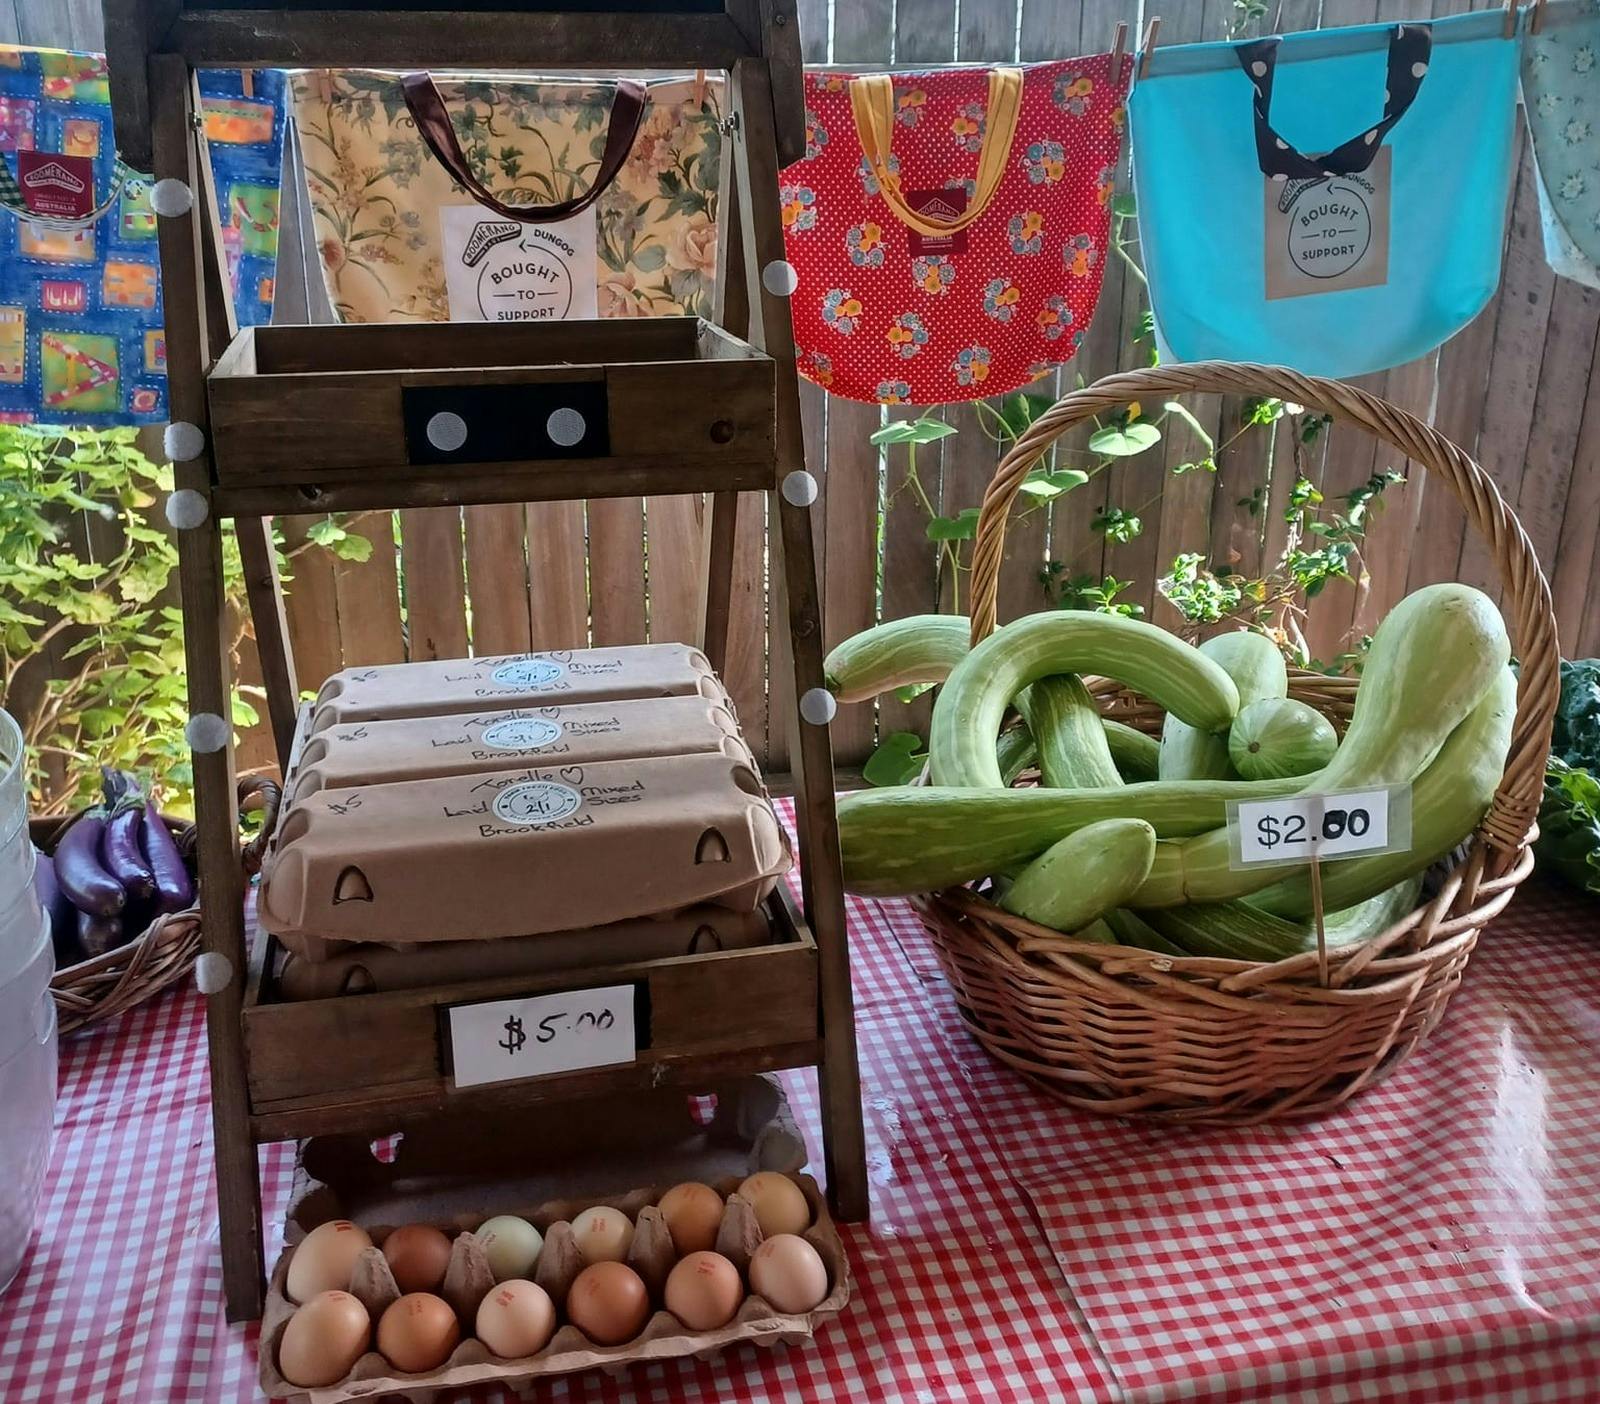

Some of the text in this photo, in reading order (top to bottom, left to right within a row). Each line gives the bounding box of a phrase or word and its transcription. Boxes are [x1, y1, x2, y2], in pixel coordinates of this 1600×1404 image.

[35, 201, 76, 212] AUSTRALIA
[1300, 203, 1359, 227] BOUGHT
[1322, 228, 1337, 238] TO
[466, 224, 516, 260] BOOMERANG
[534, 228, 575, 257] DUNGOG
[1302, 244, 1356, 260] SUPPORT
[490, 262, 560, 285] BOUGHT
[517, 290, 536, 300] TO
[497, 307, 555, 321] SUPPORT
[431, 734, 473, 748] Laid
[471, 744, 571, 760] Brookfield
[580, 780, 646, 797] Mixed
[327, 793, 362, 815] $5
[585, 794, 643, 806] Sizes
[443, 800, 490, 818] Laid
[479, 815, 595, 838] Brookfield
[1257, 808, 1370, 849] $2.00
